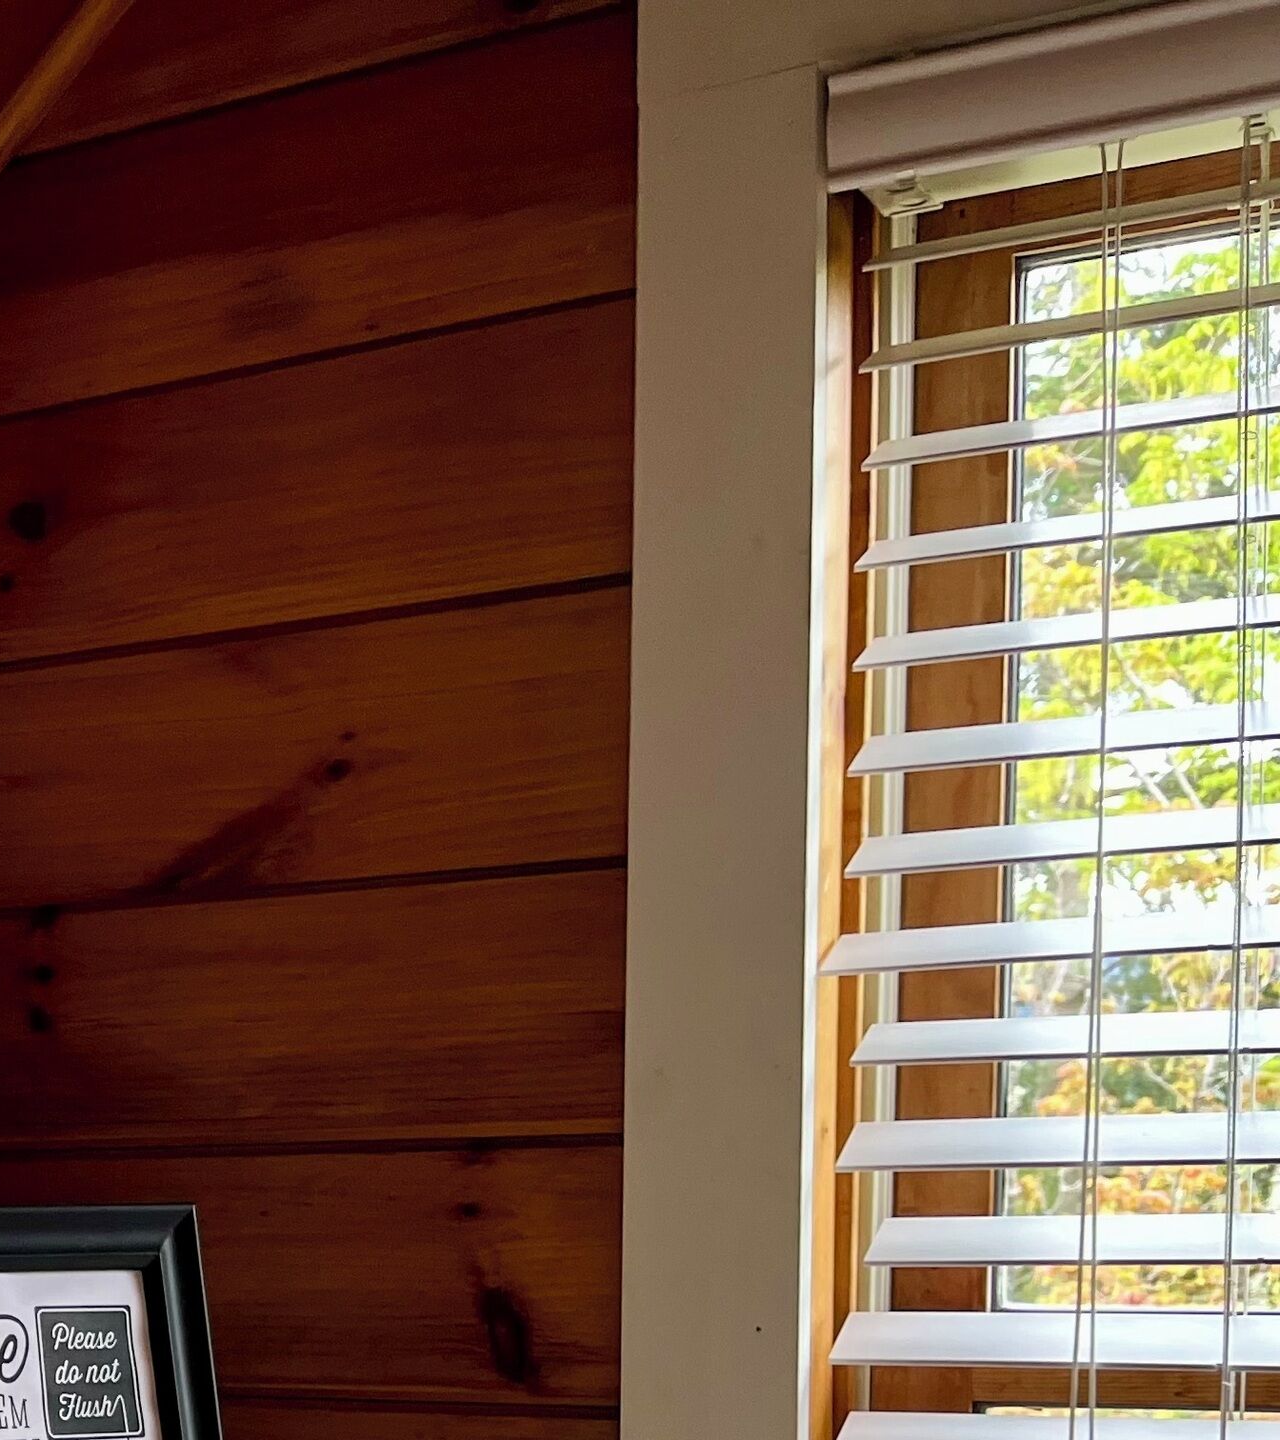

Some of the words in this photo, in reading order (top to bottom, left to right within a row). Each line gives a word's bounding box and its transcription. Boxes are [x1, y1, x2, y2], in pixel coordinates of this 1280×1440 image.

[51, 1321, 117, 1351] Please
[55, 1360, 83, 1384] do
[85, 1358, 121, 1383] not
[58, 1391, 122, 1421] Flush
